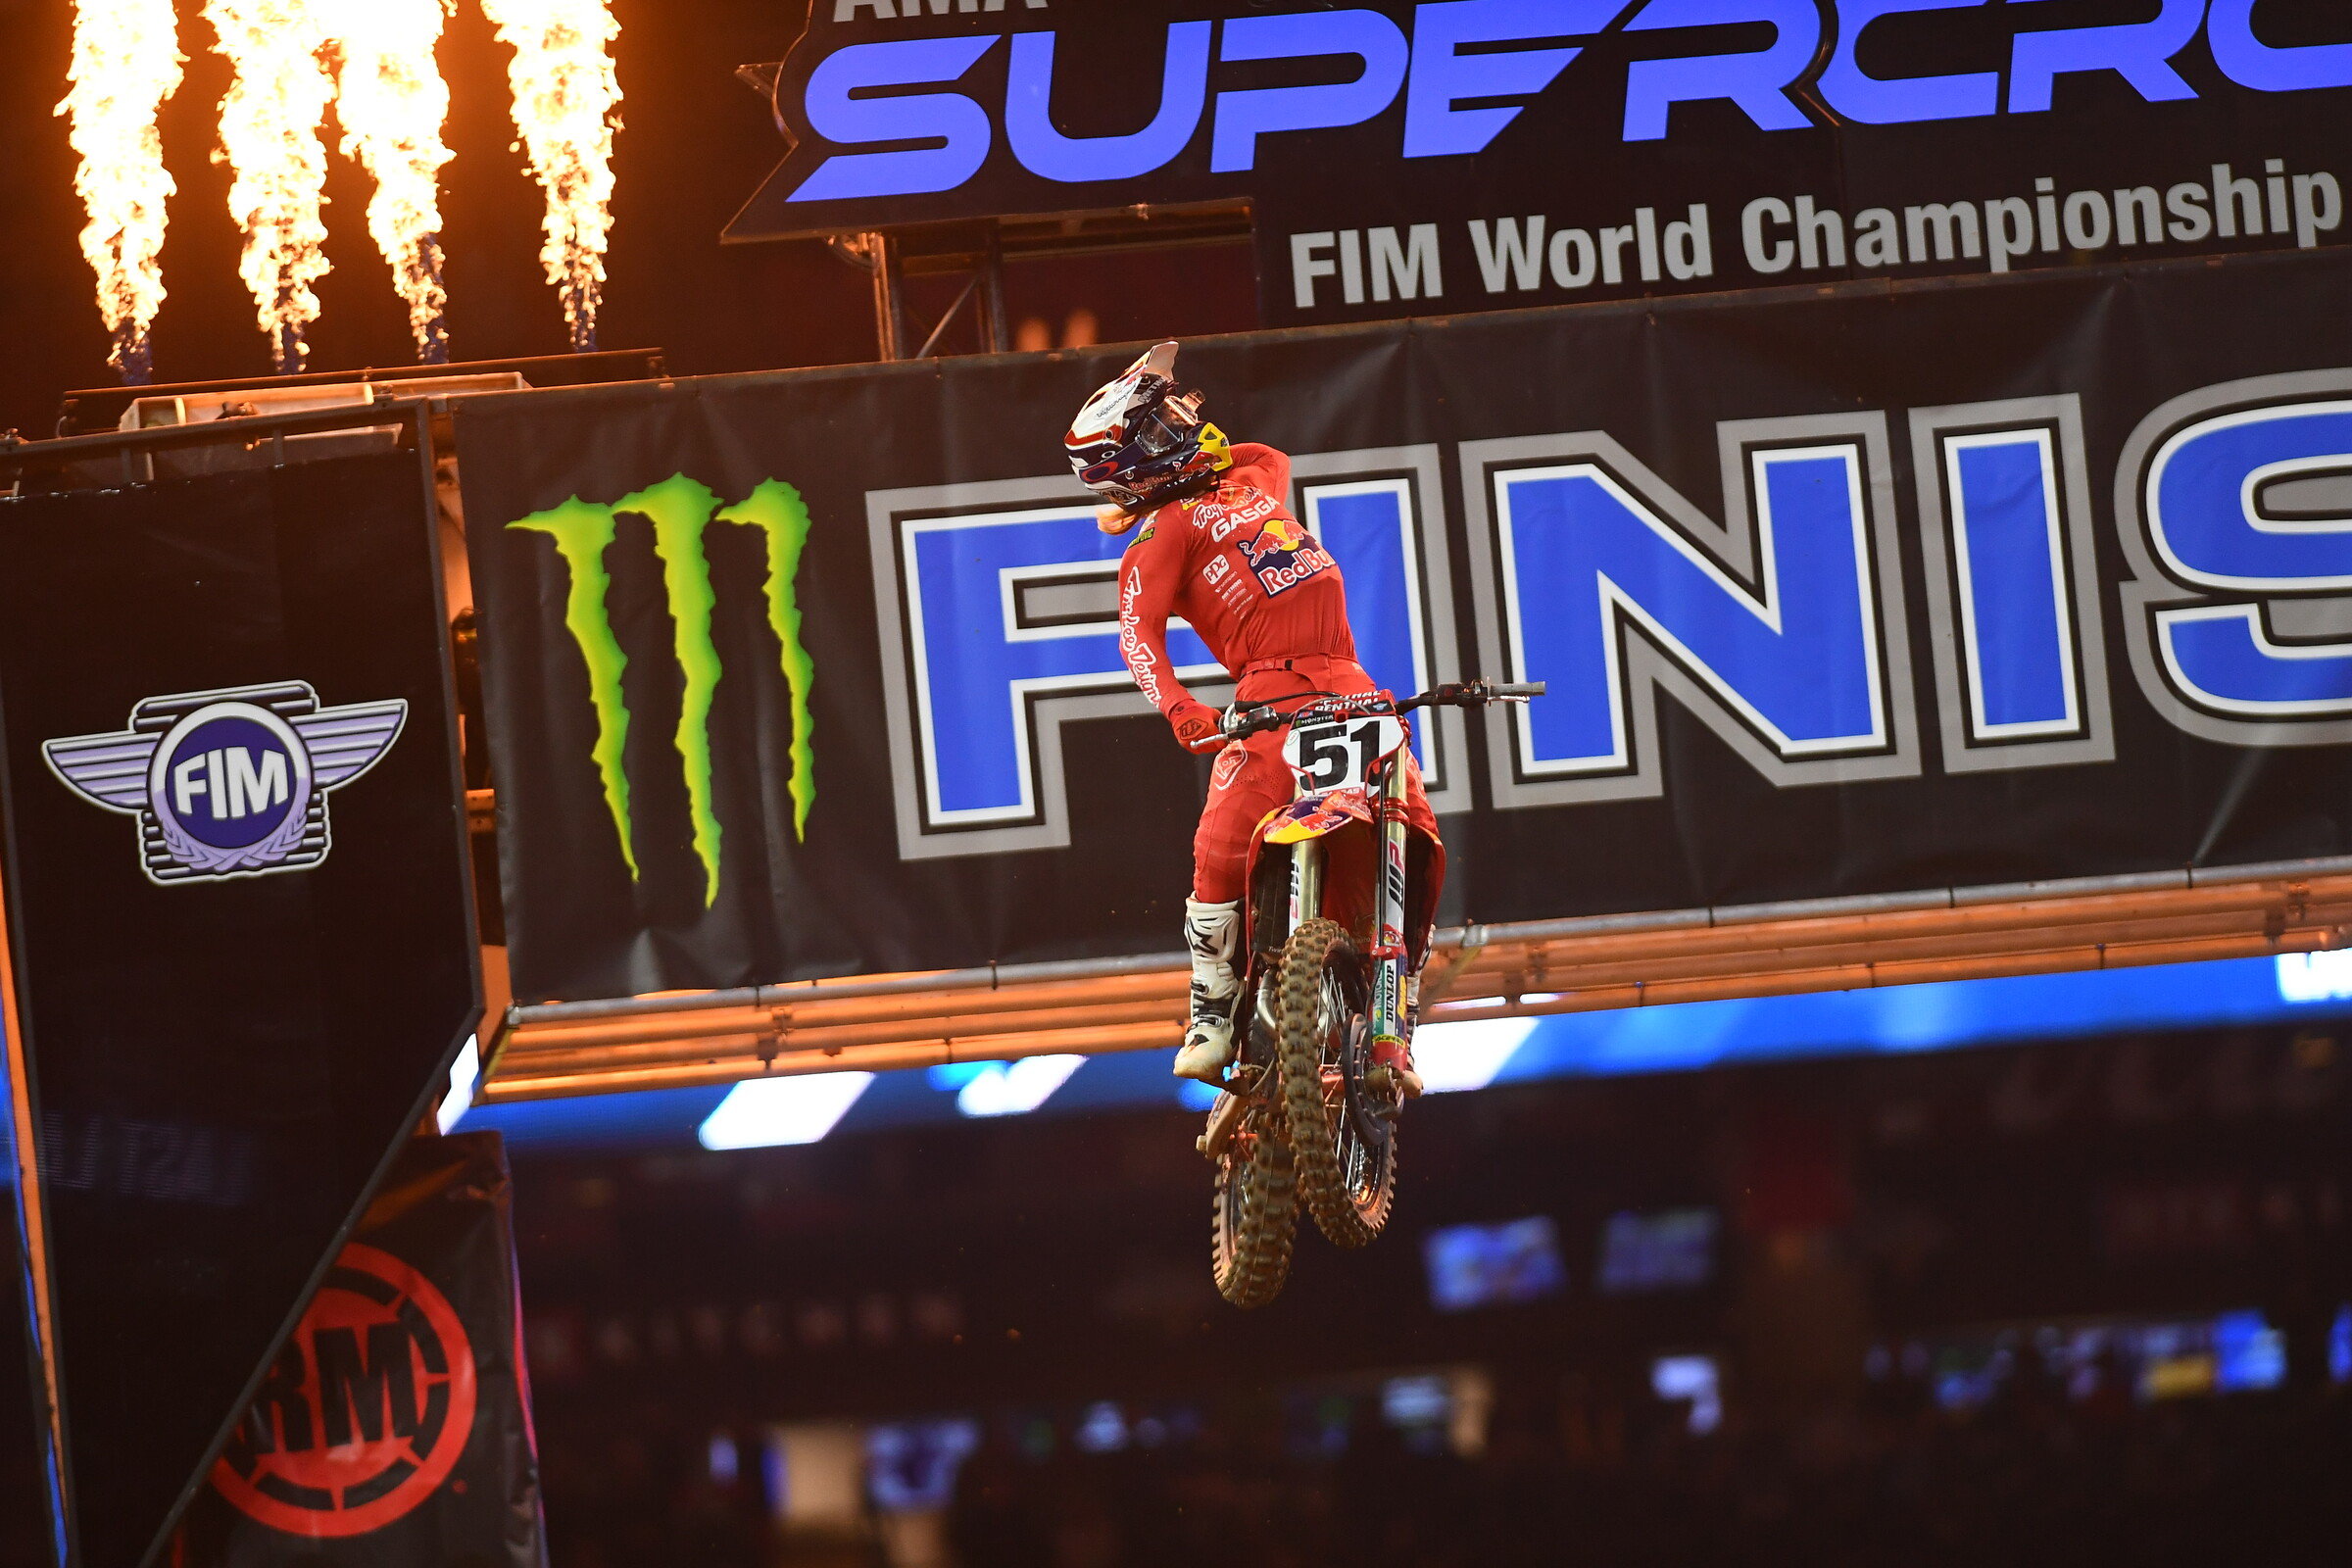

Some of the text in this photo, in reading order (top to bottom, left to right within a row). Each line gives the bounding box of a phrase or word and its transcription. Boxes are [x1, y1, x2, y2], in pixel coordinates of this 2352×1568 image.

[1291, 158, 2342, 308] FIM World Championship
[1192, 503, 1223, 529] Troy
[1204, 557, 1228, 582] PPG
[1257, 552, 1311, 596] Red
[1300, 713, 1334, 725] MONSTER
[1299, 720, 1382, 792] 51
[173, 746, 289, 821] FIM
[1386, 964, 1395, 1023] DUNLOP
